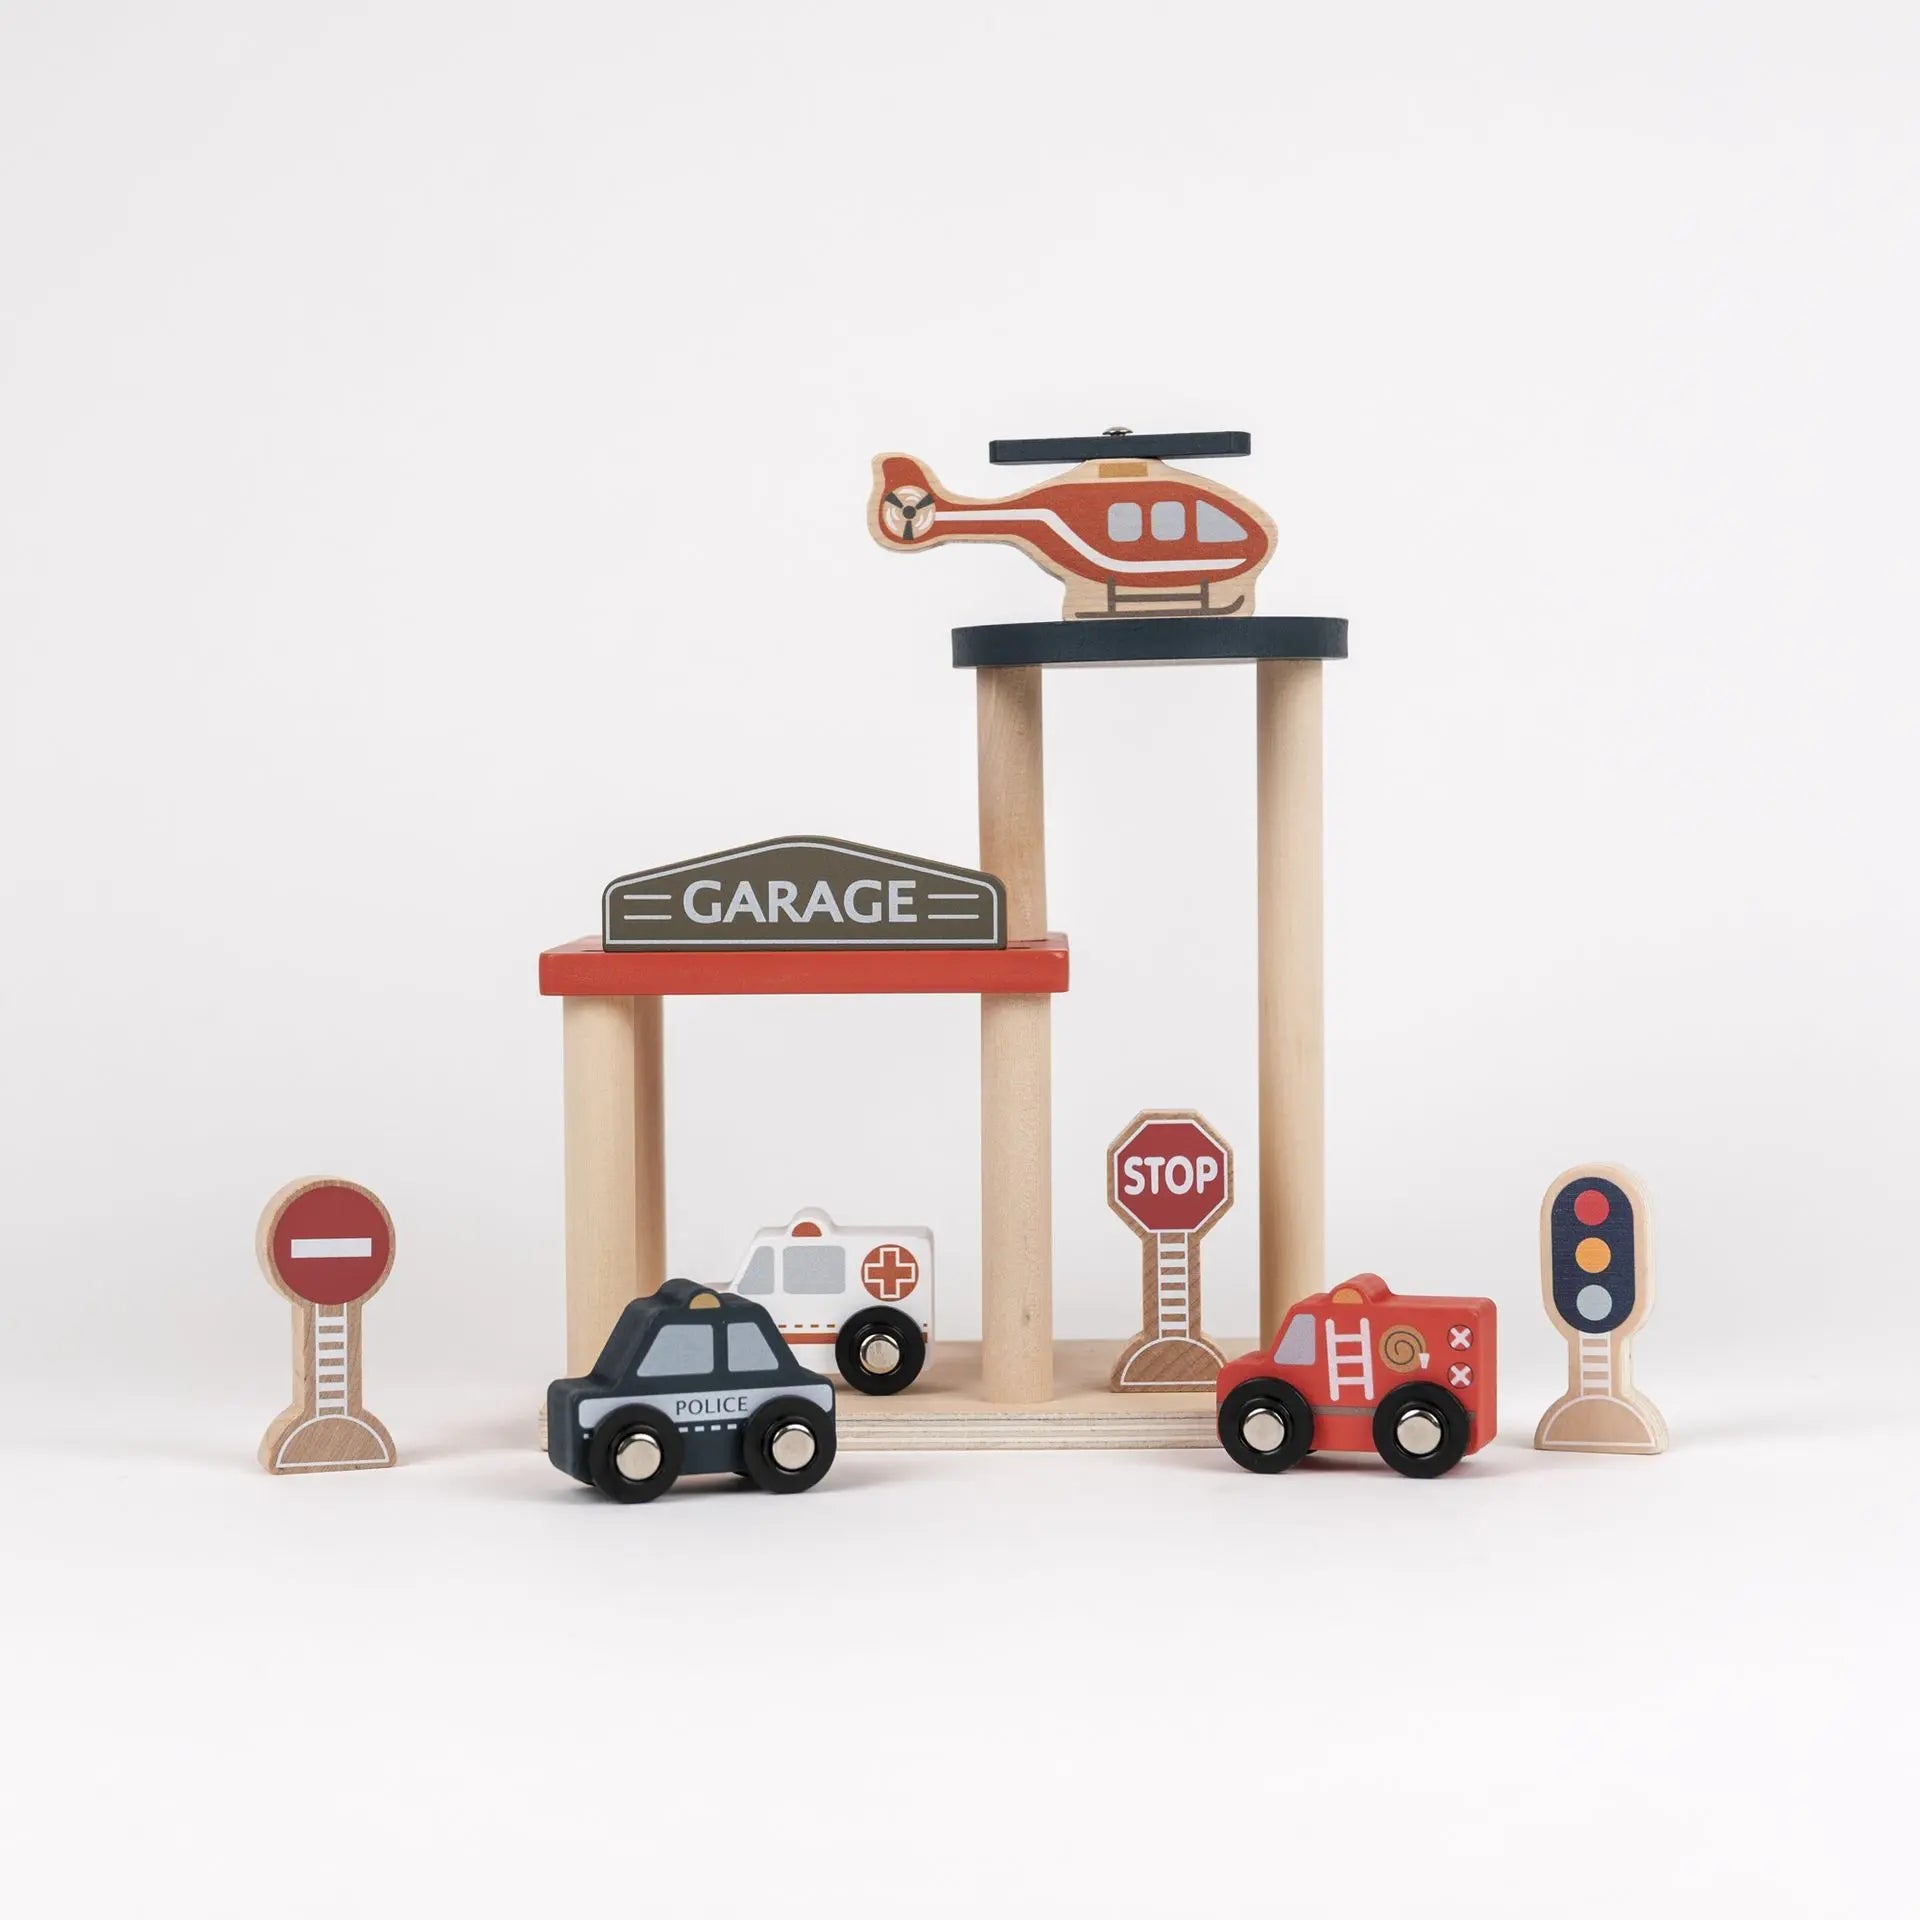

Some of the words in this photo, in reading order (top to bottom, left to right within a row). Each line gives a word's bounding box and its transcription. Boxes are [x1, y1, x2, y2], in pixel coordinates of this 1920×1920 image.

[682, 879, 918, 924] GARAGE
[1123, 1155, 1219, 1196] STOP
[676, 1396, 748, 1415] POLICE
